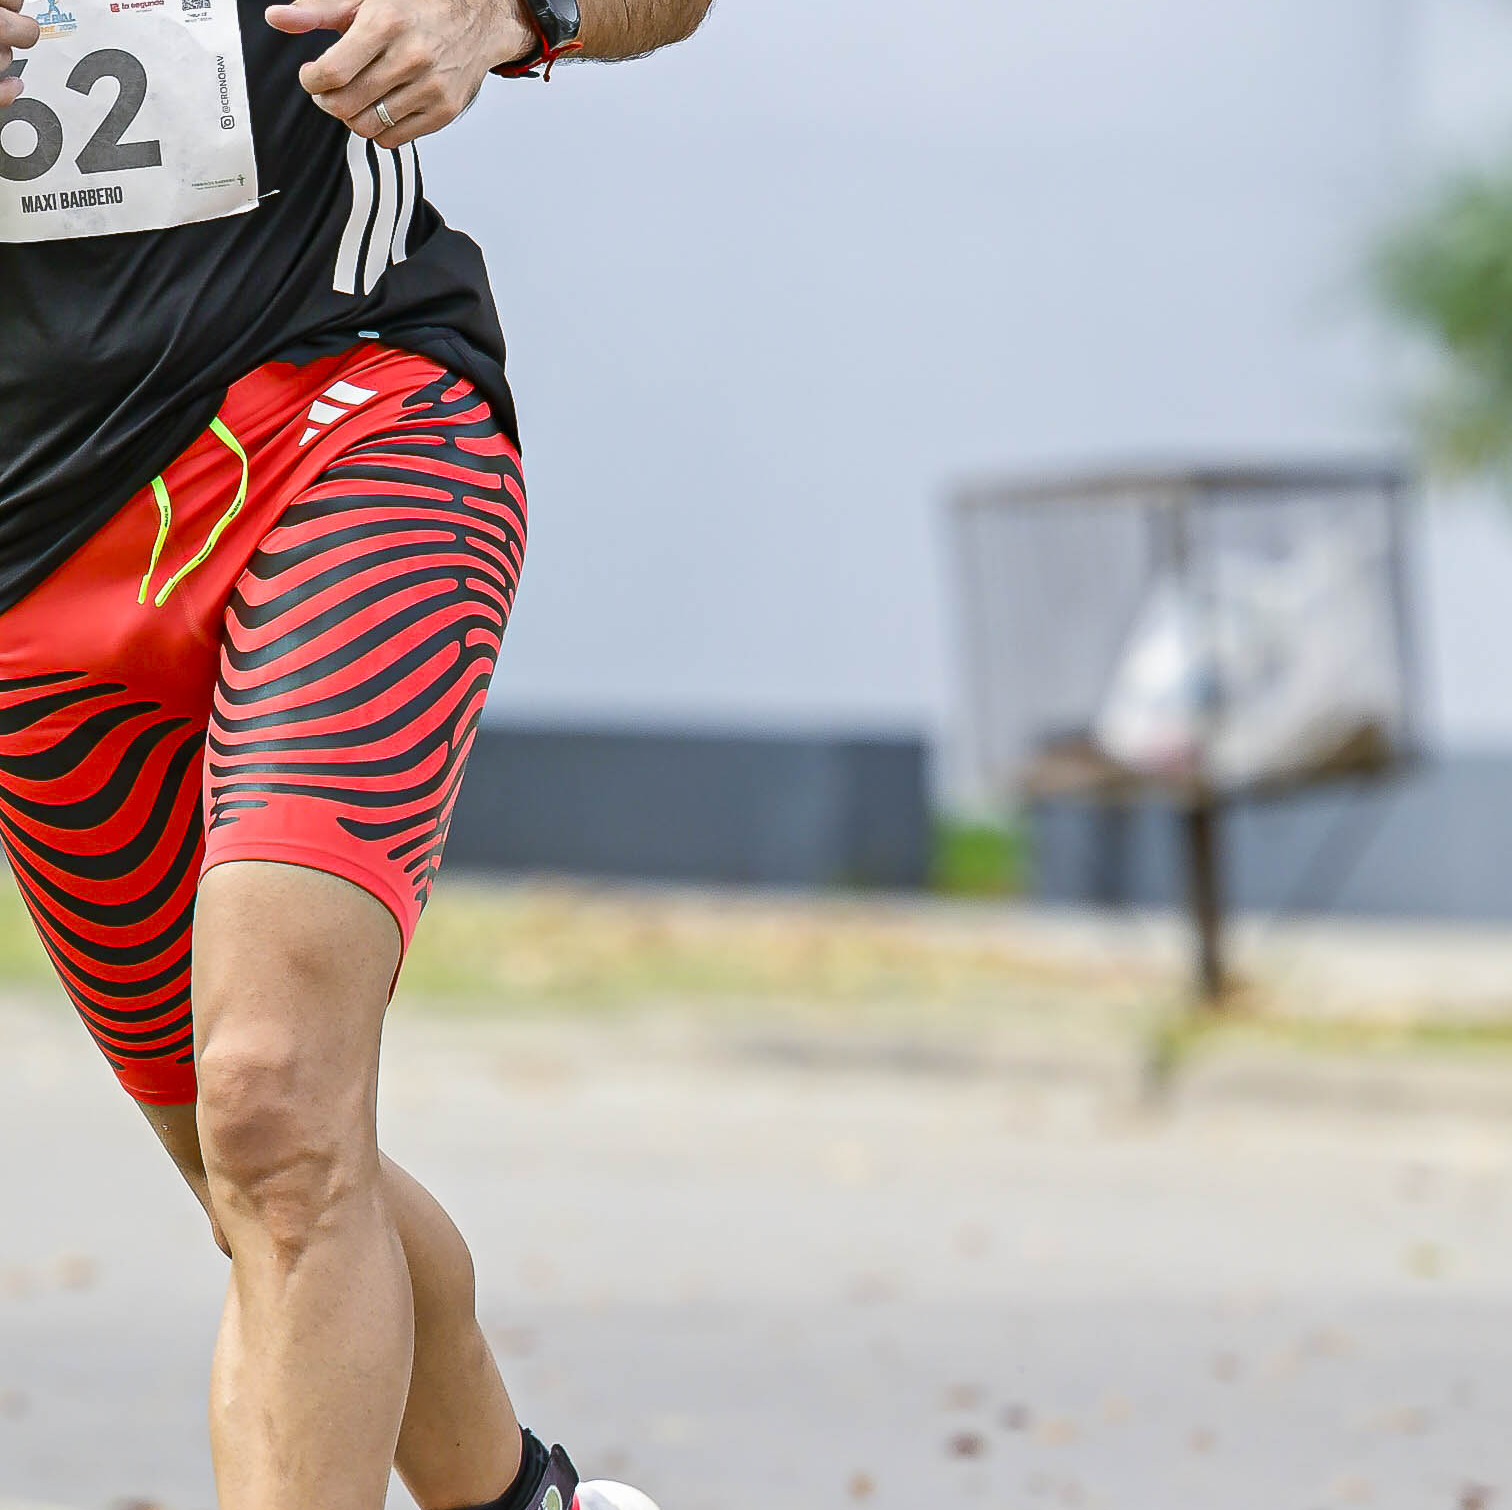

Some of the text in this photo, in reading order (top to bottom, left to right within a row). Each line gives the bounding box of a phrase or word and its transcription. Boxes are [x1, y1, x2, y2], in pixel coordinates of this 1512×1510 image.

[216, 55, 231, 113] @CRONORAV
[21, 185, 123, 214] MAXI BARBERO
